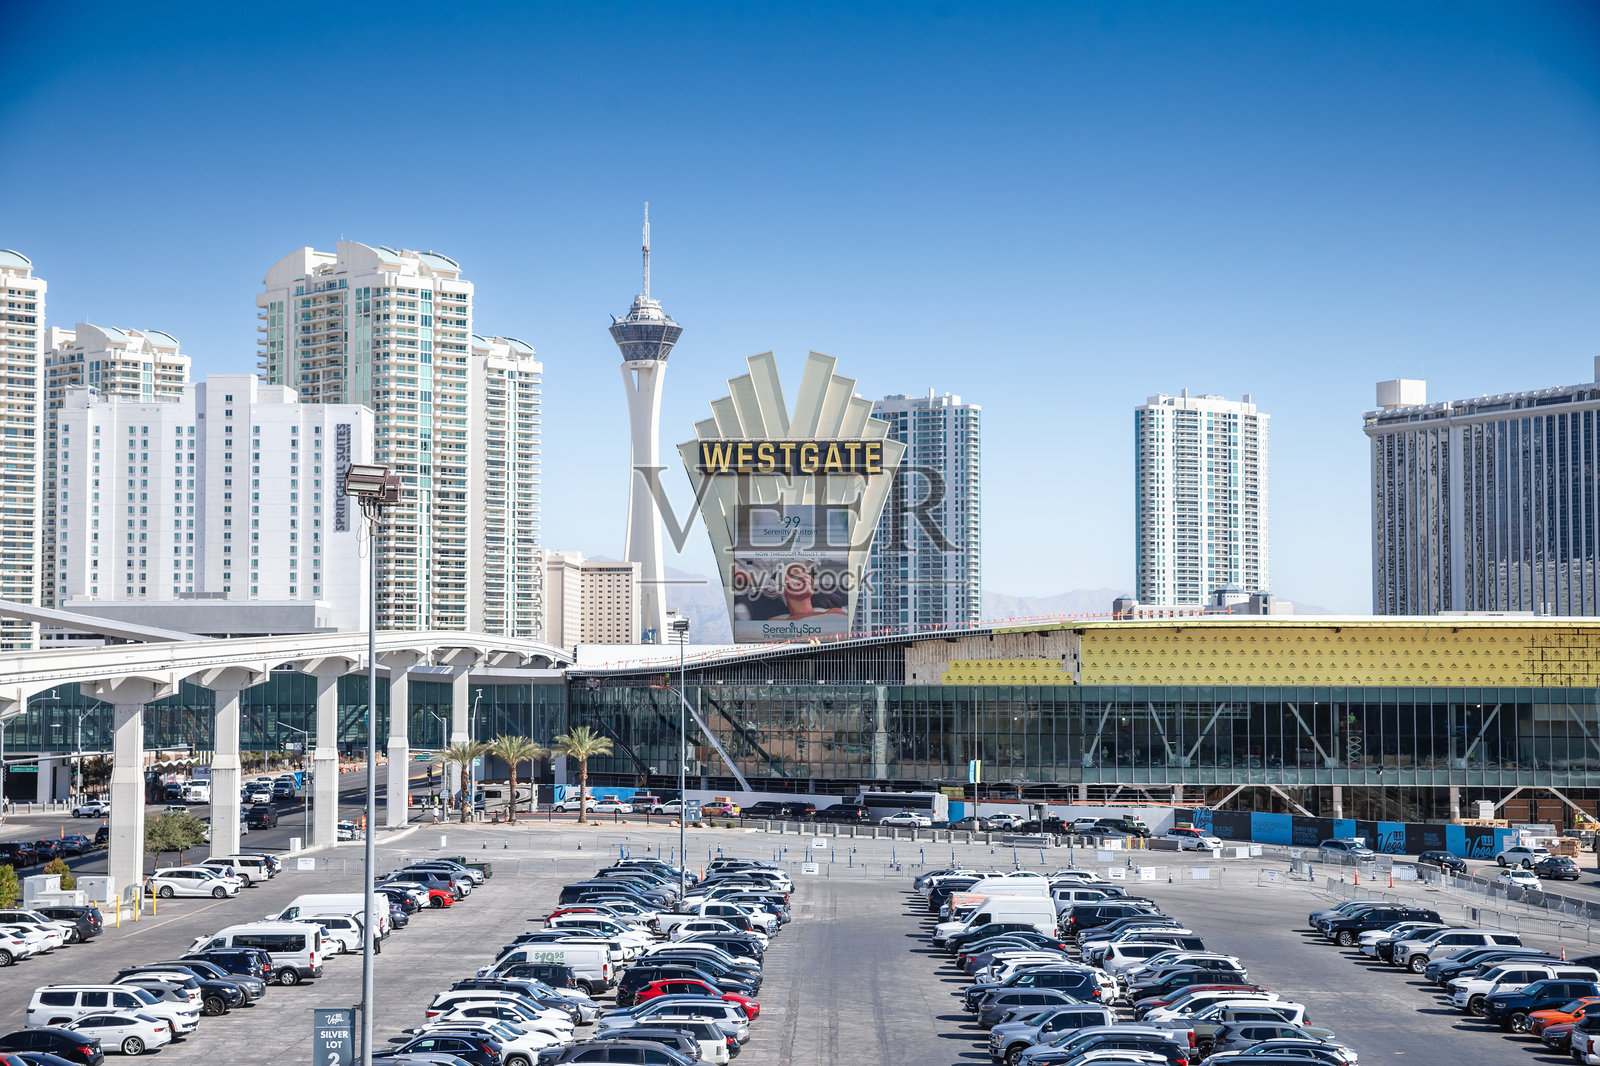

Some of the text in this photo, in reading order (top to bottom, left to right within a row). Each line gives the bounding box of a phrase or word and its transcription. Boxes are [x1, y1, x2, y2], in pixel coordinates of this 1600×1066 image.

[702, 443, 881, 473] WESTGATE
[336, 424, 345, 531] SPRINGHILL SUITES
[763, 528, 791, 537] Serenity
[1378, 831, 1406, 854] Vegas
[1465, 836, 1495, 858] Vegas
[320, 1030, 348, 1038] SILVER
[328, 1052, 340, 1066] 2
